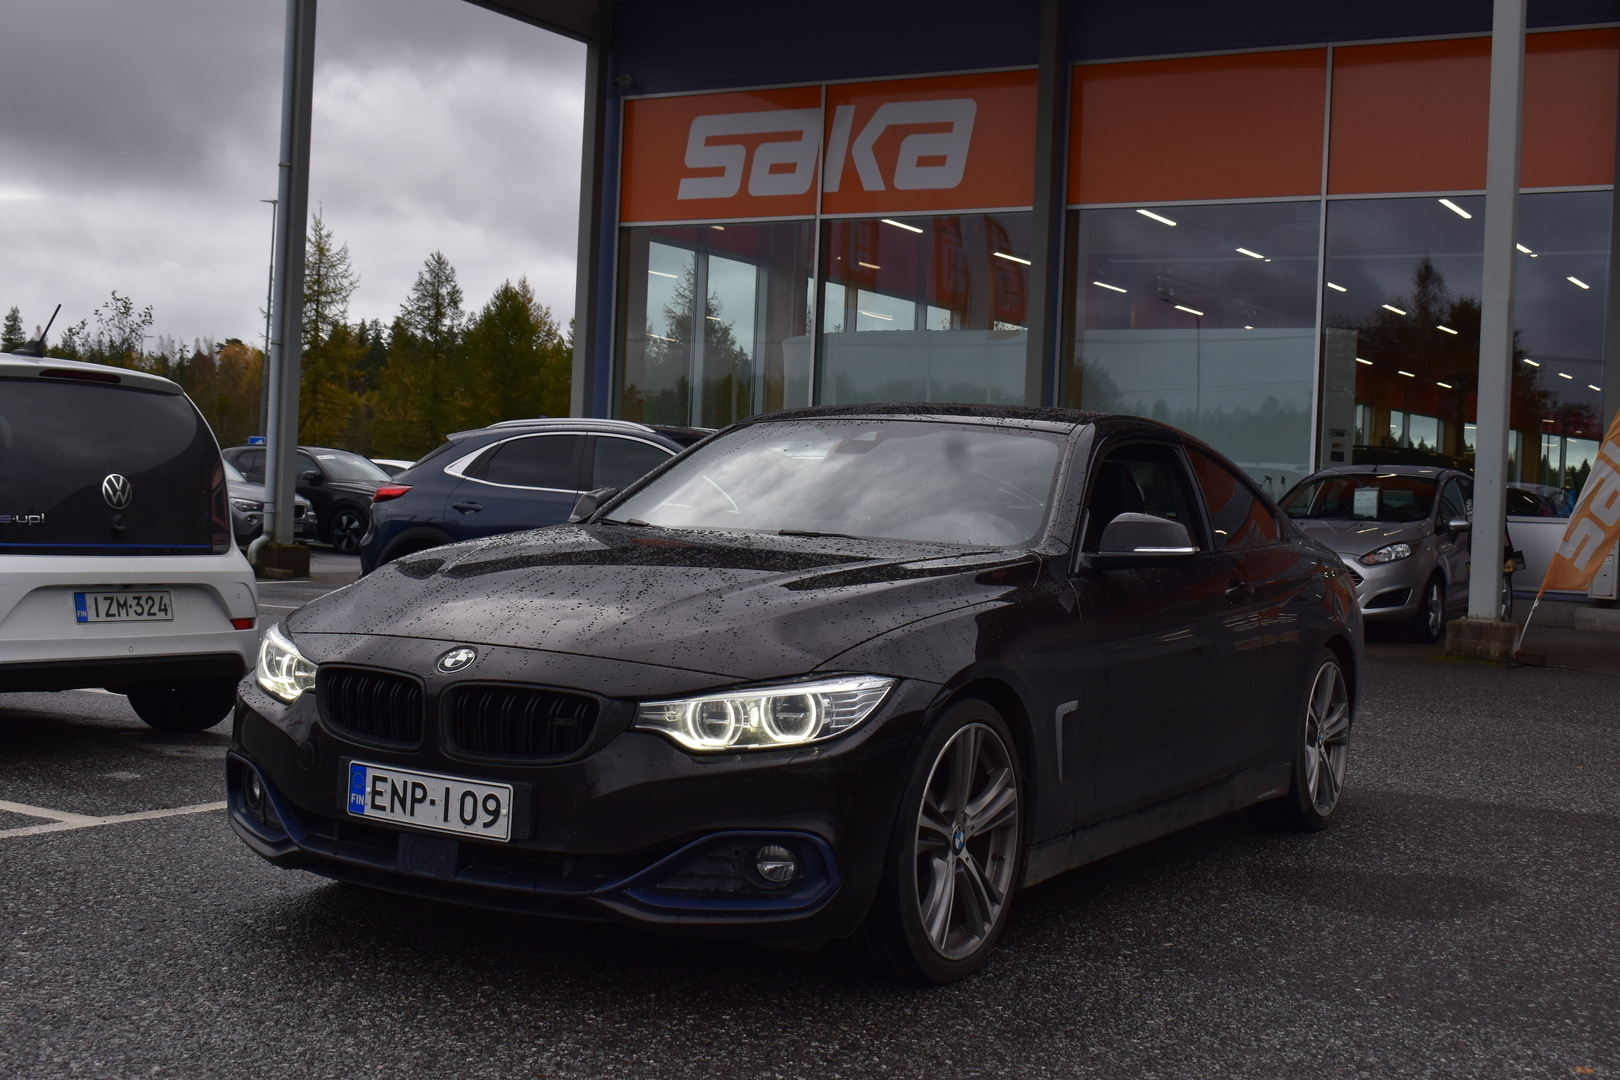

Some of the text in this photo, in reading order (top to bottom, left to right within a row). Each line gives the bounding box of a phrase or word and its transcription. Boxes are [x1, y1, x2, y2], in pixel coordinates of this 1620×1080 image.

[93, 595, 168, 618] IZM-324
[350, 774, 501, 828] FIN ENP-109
